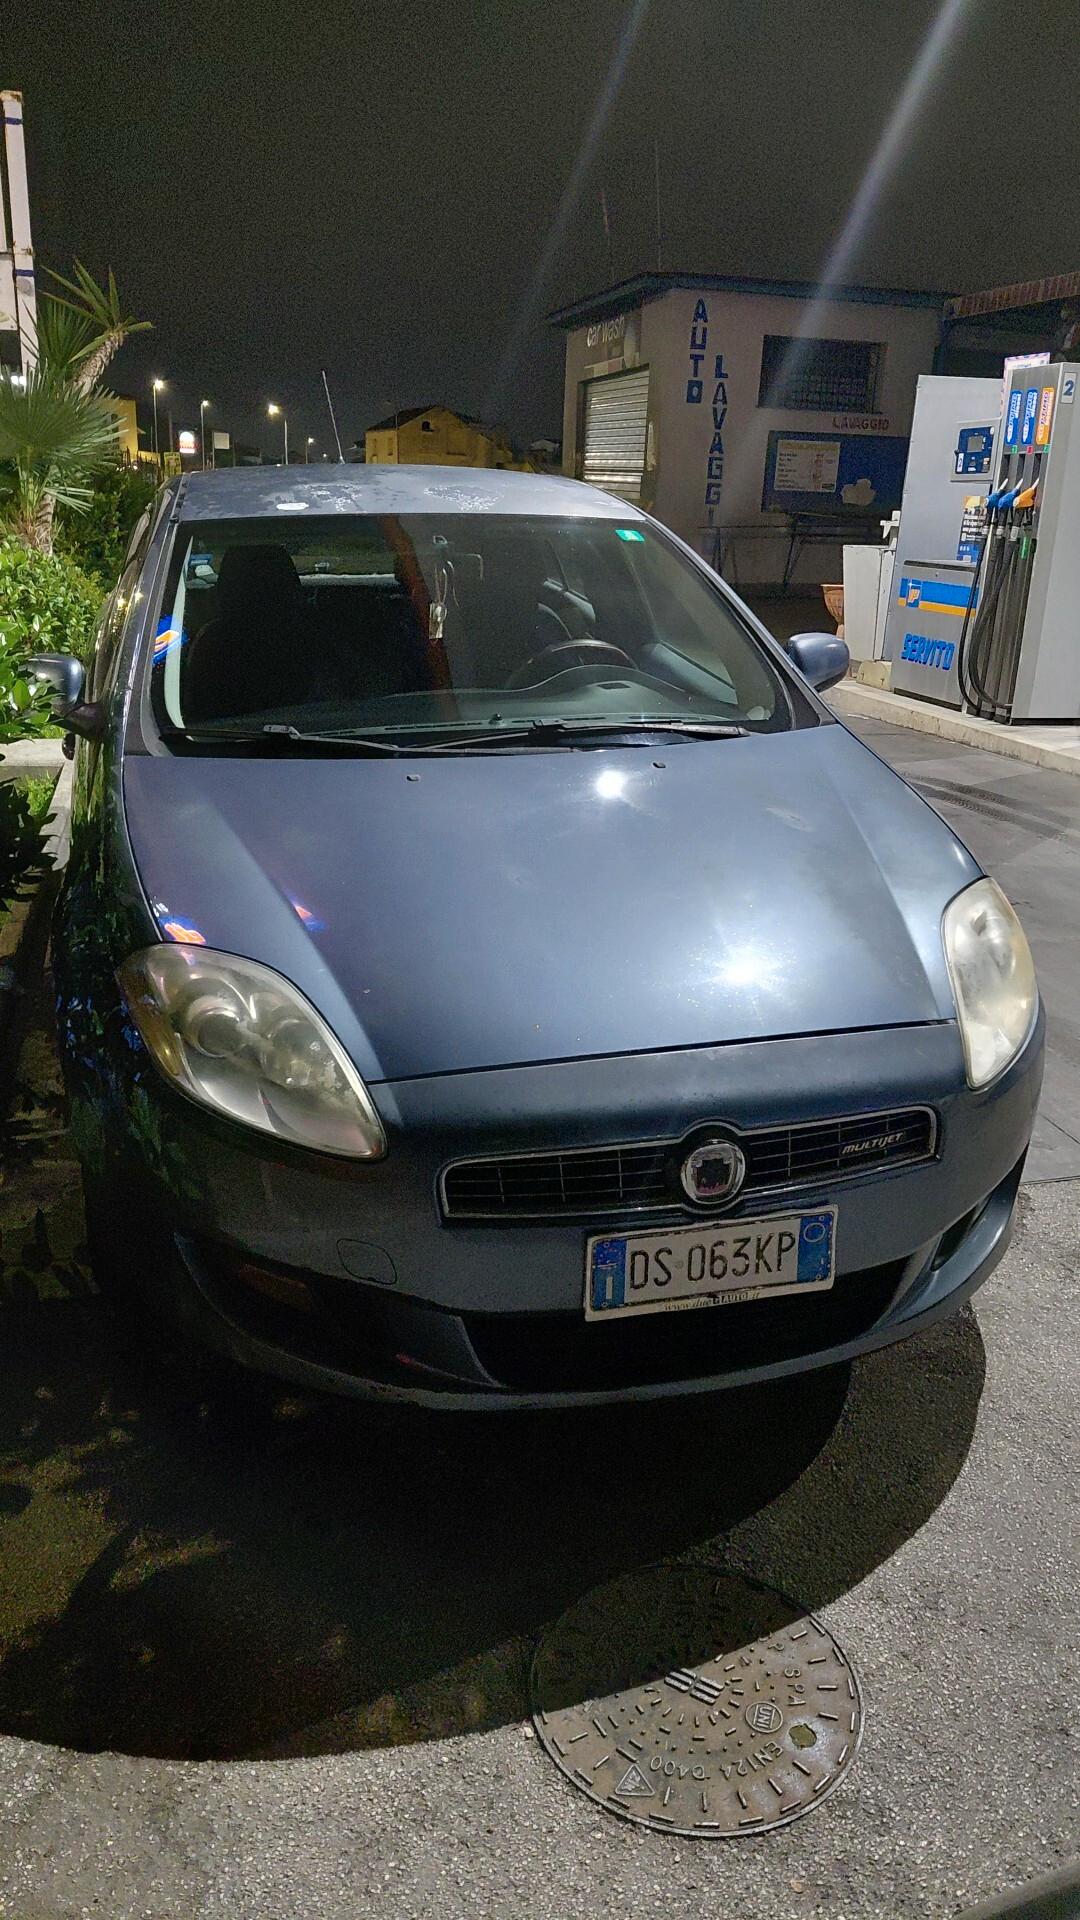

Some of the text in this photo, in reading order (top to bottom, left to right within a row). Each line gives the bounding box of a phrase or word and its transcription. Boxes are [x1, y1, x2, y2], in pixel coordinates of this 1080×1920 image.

[686, 298, 708, 404] AUTO
[1063, 379, 1075, 397] 2
[832, 416, 890, 431] LAVAGGIO
[901, 633, 956, 671] SERVITO
[842, 1132, 904, 1155] MULTIJET
[629, 1246, 673, 1290] DS
[687, 1231, 797, 1282] 063KP
[754, 1705, 775, 1729] UNI
